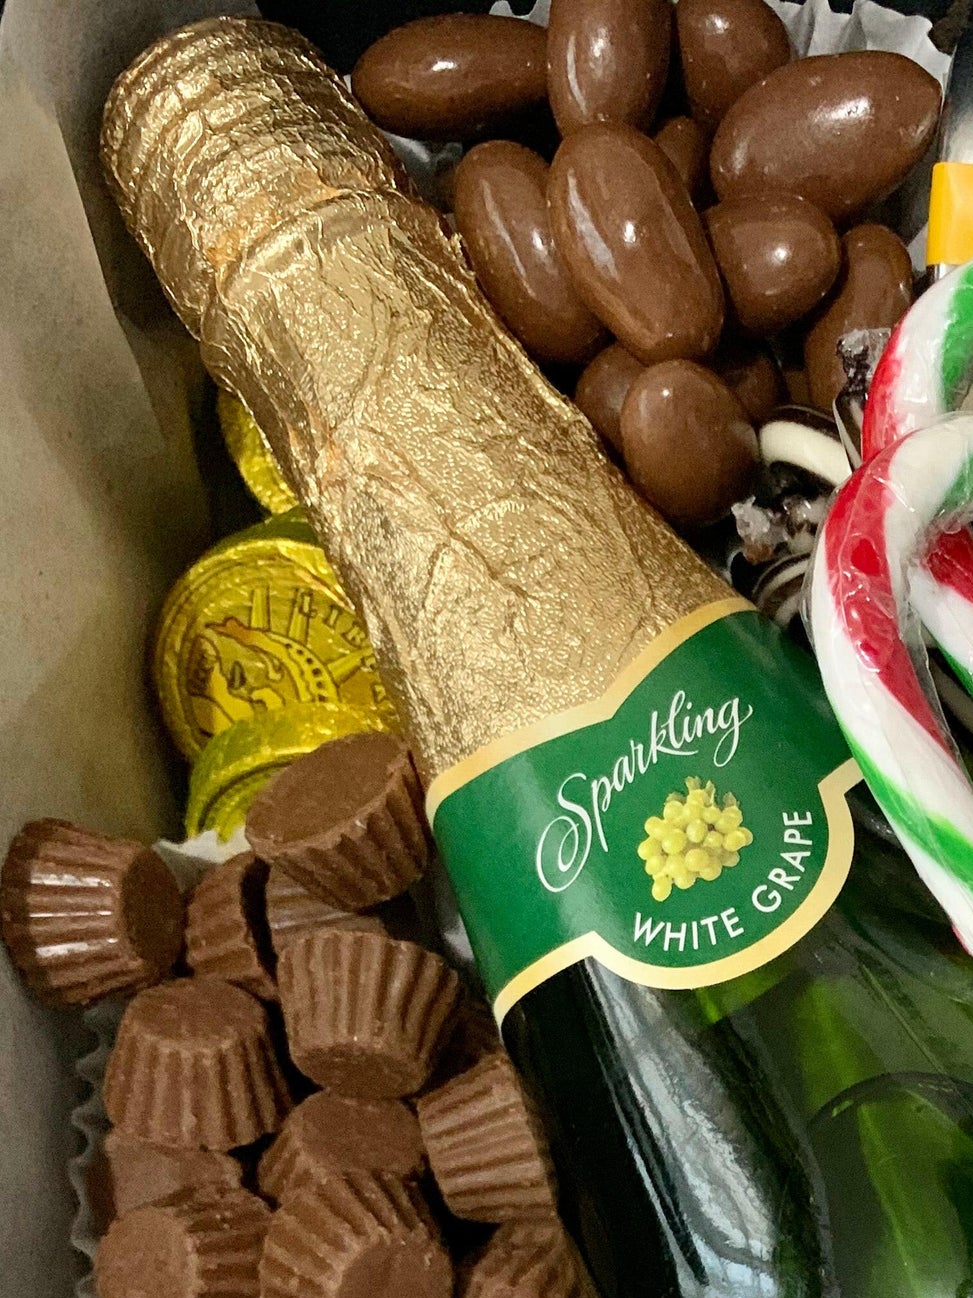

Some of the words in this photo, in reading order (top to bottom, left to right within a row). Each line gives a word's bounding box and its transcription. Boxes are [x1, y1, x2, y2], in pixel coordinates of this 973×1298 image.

[535, 690, 753, 893] Sparkling
[633, 907, 744, 952] WHITE
[751, 811, 813, 913] GRAPE
